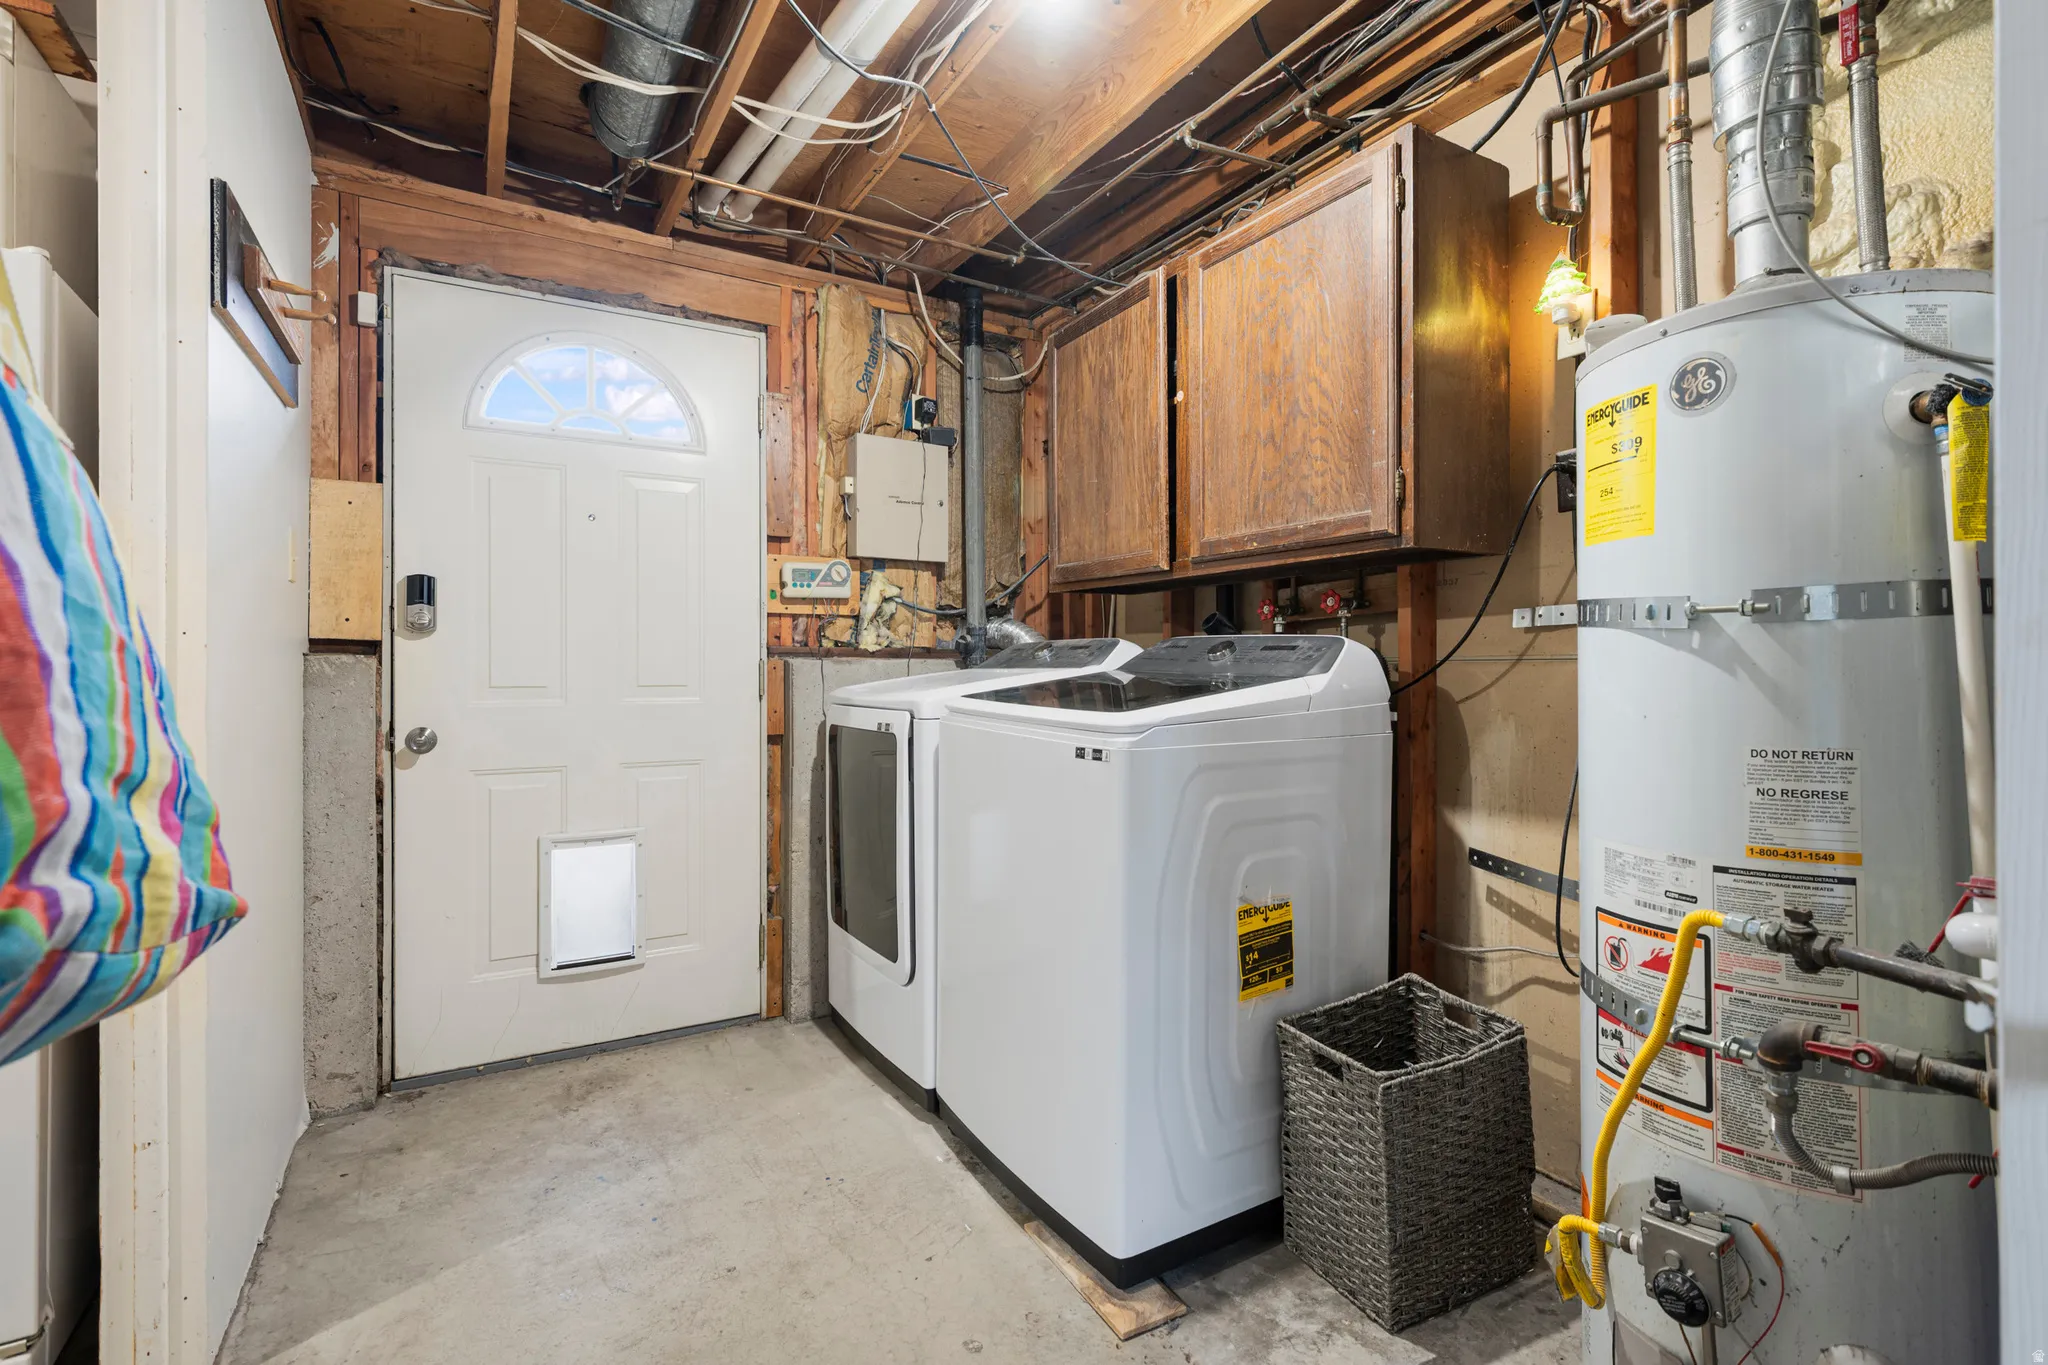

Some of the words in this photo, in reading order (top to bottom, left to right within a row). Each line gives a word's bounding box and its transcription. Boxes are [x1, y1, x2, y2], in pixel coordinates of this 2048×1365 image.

[855, 308, 882, 393] CertainTe
[1586, 391, 1650, 428] ENERGYGUIDE
[1599, 487, 1614, 498] 254
[1750, 748, 1768, 759] DO
[1771, 749, 1798, 759] NOT
[1801, 750, 1854, 761] RETURN
[1756, 787, 1776, 798] NO
[1780, 788, 1849, 801] REGRESE
[1749, 848, 1835, 862] 1-800-431-1549
[1728, 868, 1767, 878] INSTALLATION
[1781, 873, 1814, 882] OPERATION
[1733, 878, 1764, 887] AUTOMATIC
[1765, 881, 1791, 889] STORAGE
[1238, 901, 1291, 923] ENERGYGUIDE
[1626, 924, 1666, 940] WARNING
[1745, 990, 1758, 998] YOUR
[1758, 992, 1777, 1000] SAFETY
[1777, 995, 1790, 1003] READ
[1791, 998, 1810, 1006] BEFORE
[1810, 1001, 1838, 1009] OPERATING
[1626, 1024, 1649, 1039] DANG
[1634, 1093, 1665, 1112] ARNING
[1752, 1154, 1765, 1162] TURN
